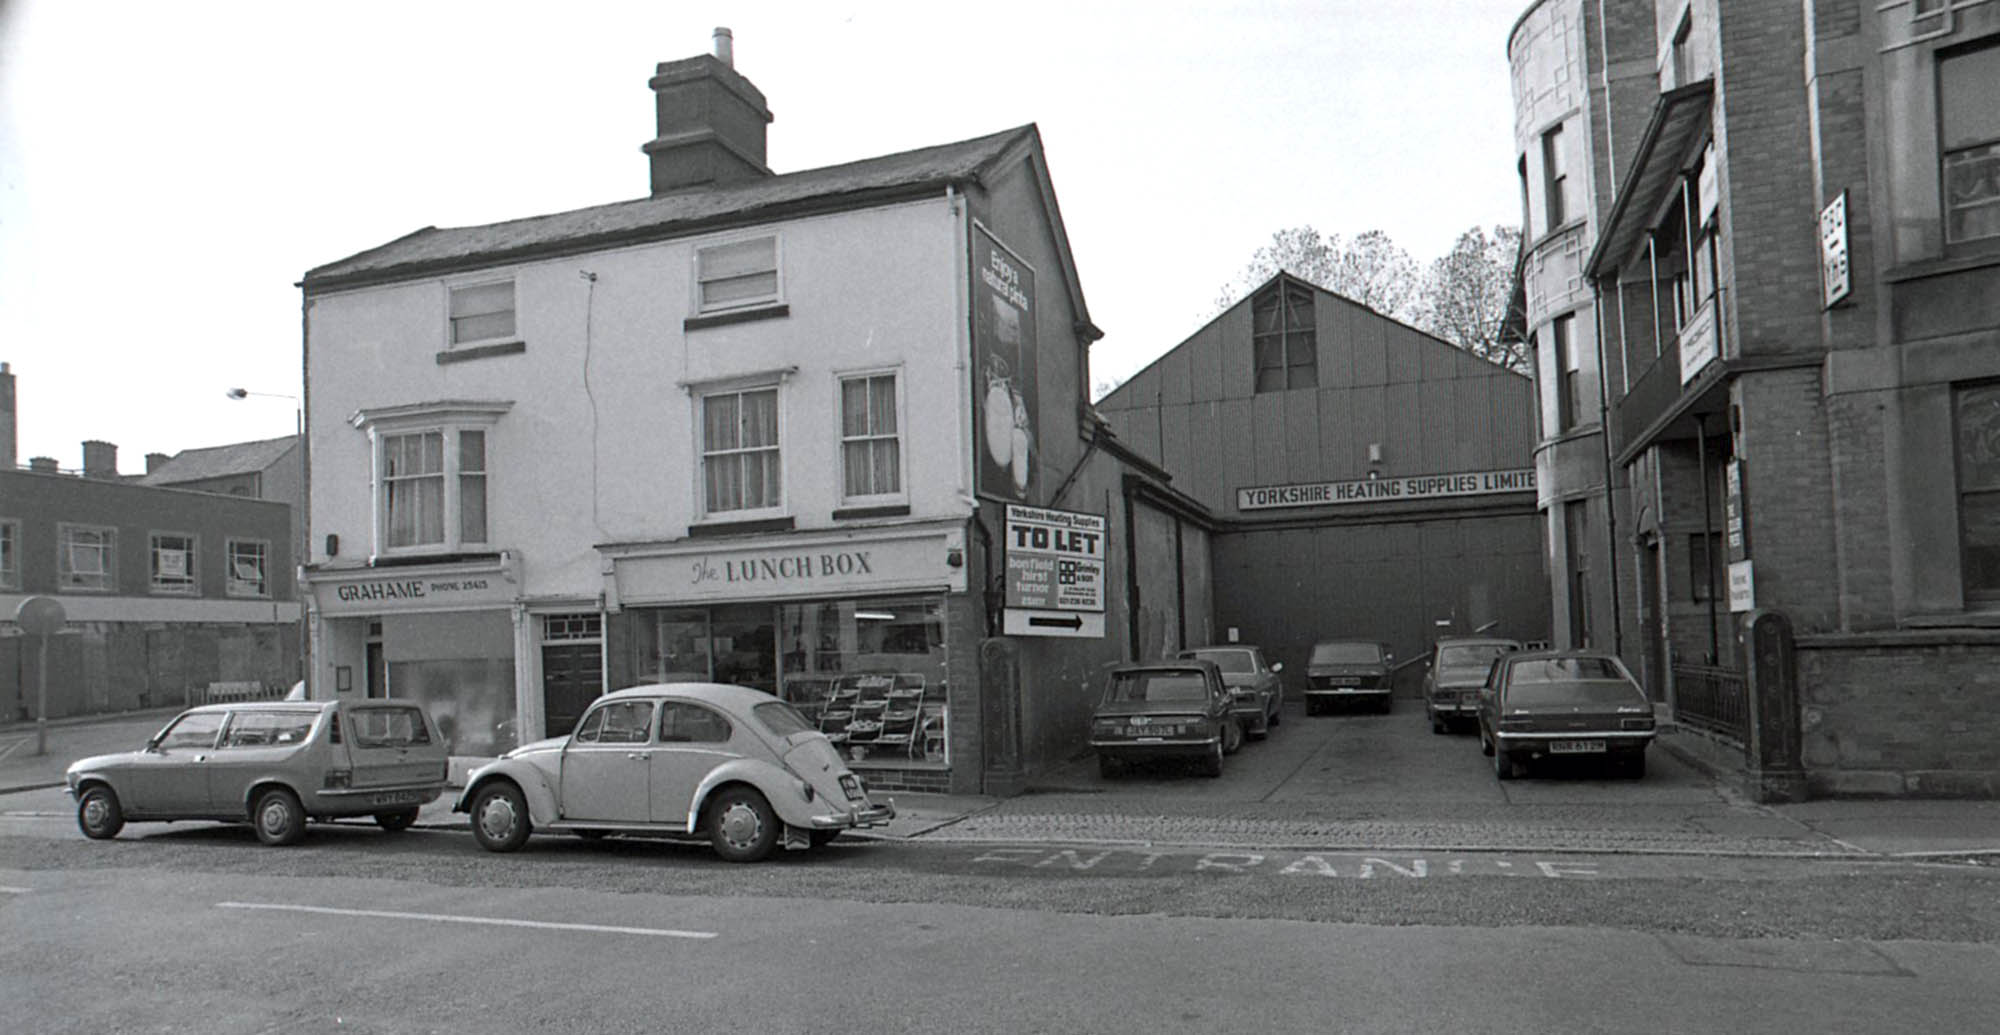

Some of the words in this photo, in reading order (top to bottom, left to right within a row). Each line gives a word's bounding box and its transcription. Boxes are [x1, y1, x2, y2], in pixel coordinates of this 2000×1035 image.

[981, 266, 1009, 298] natural
[991, 249, 1012, 284] Enjoy
[1246, 486, 1330, 506] YORKSHIRE
[1336, 481, 1401, 501] HEATING
[1407, 475, 1477, 496] SUPPLIES
[1484, 470, 1536, 491] LIMITE
[1011, 507, 1044, 520] Yorkshire
[1045, 511, 1072, 527] Heating
[1073, 514, 1099, 528] Supplies
[1011, 525, 1049, 550] TO
[1055, 529, 1099, 554] LET
[691, 556, 718, 584] The
[726, 556, 812, 582] LUNCH
[821, 552, 871, 577] BOX
[338, 580, 425, 602] GRAHAME
[431, 582, 460, 592] PHONE
